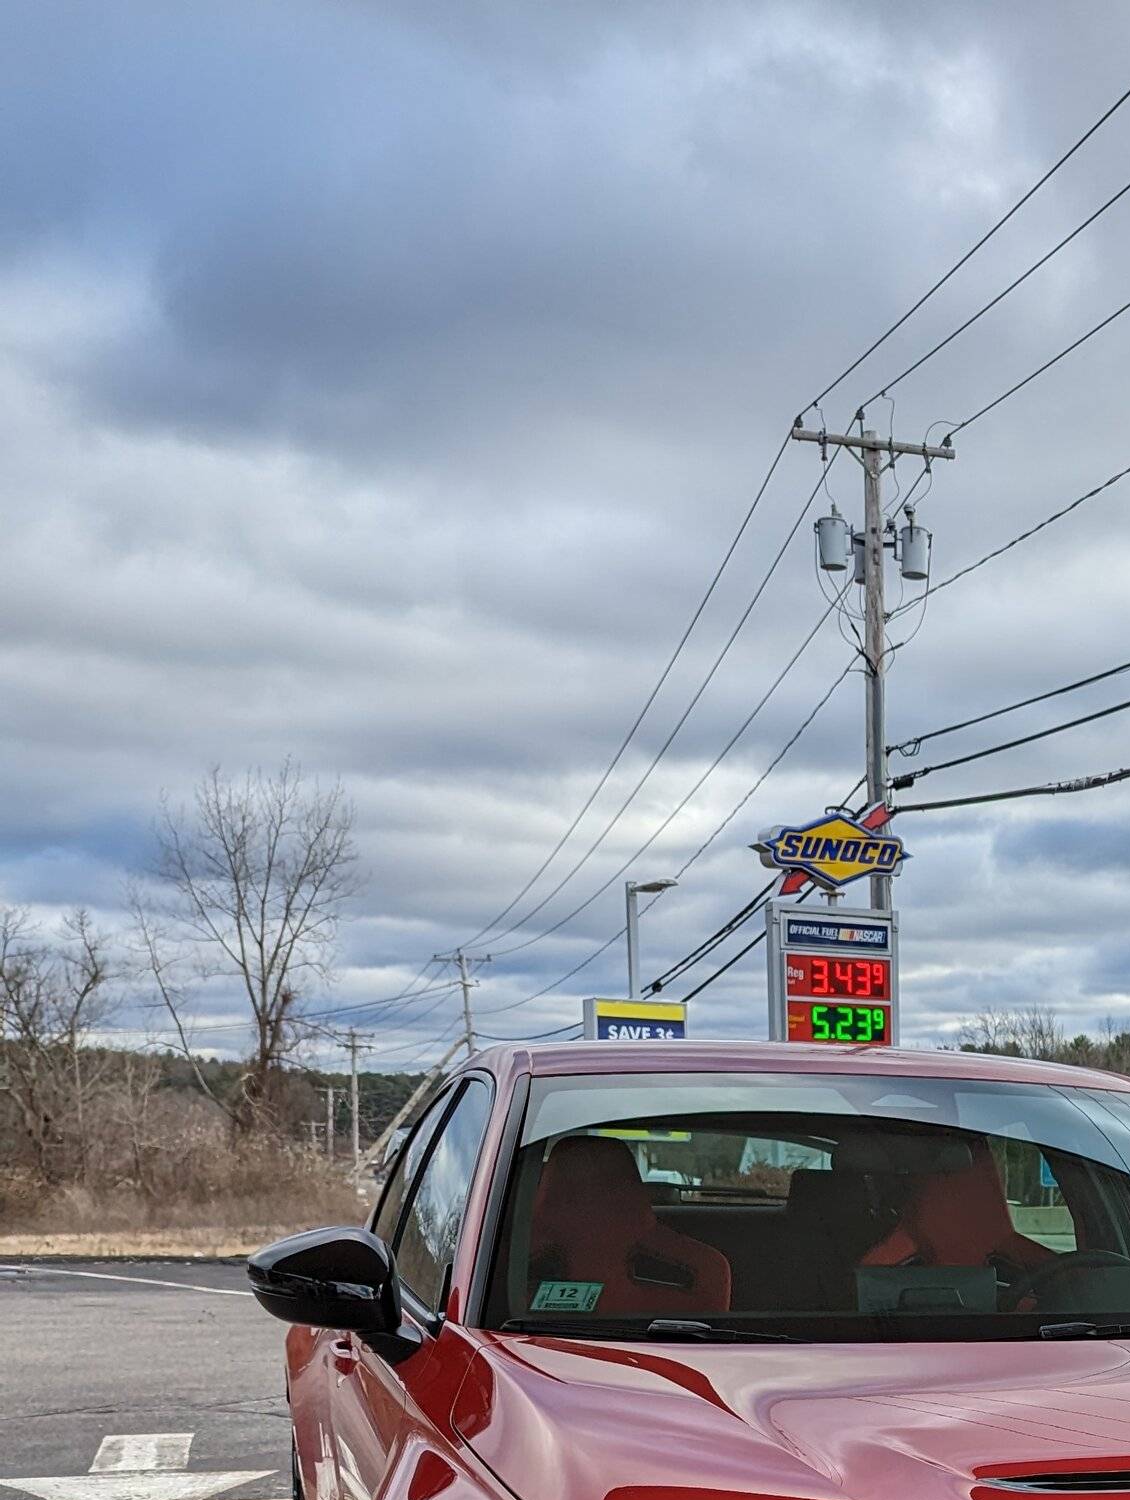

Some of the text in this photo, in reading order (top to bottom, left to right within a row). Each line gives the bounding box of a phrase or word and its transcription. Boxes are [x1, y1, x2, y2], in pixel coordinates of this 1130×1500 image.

[781, 834, 898, 866] SUNOCO
[789, 924, 886, 943] OFFICIAL FUEL NASCAR
[787, 966, 805, 980] Reg
[608, 1024, 650, 1039] SAVE
[559, 1288, 578, 1298] 12
